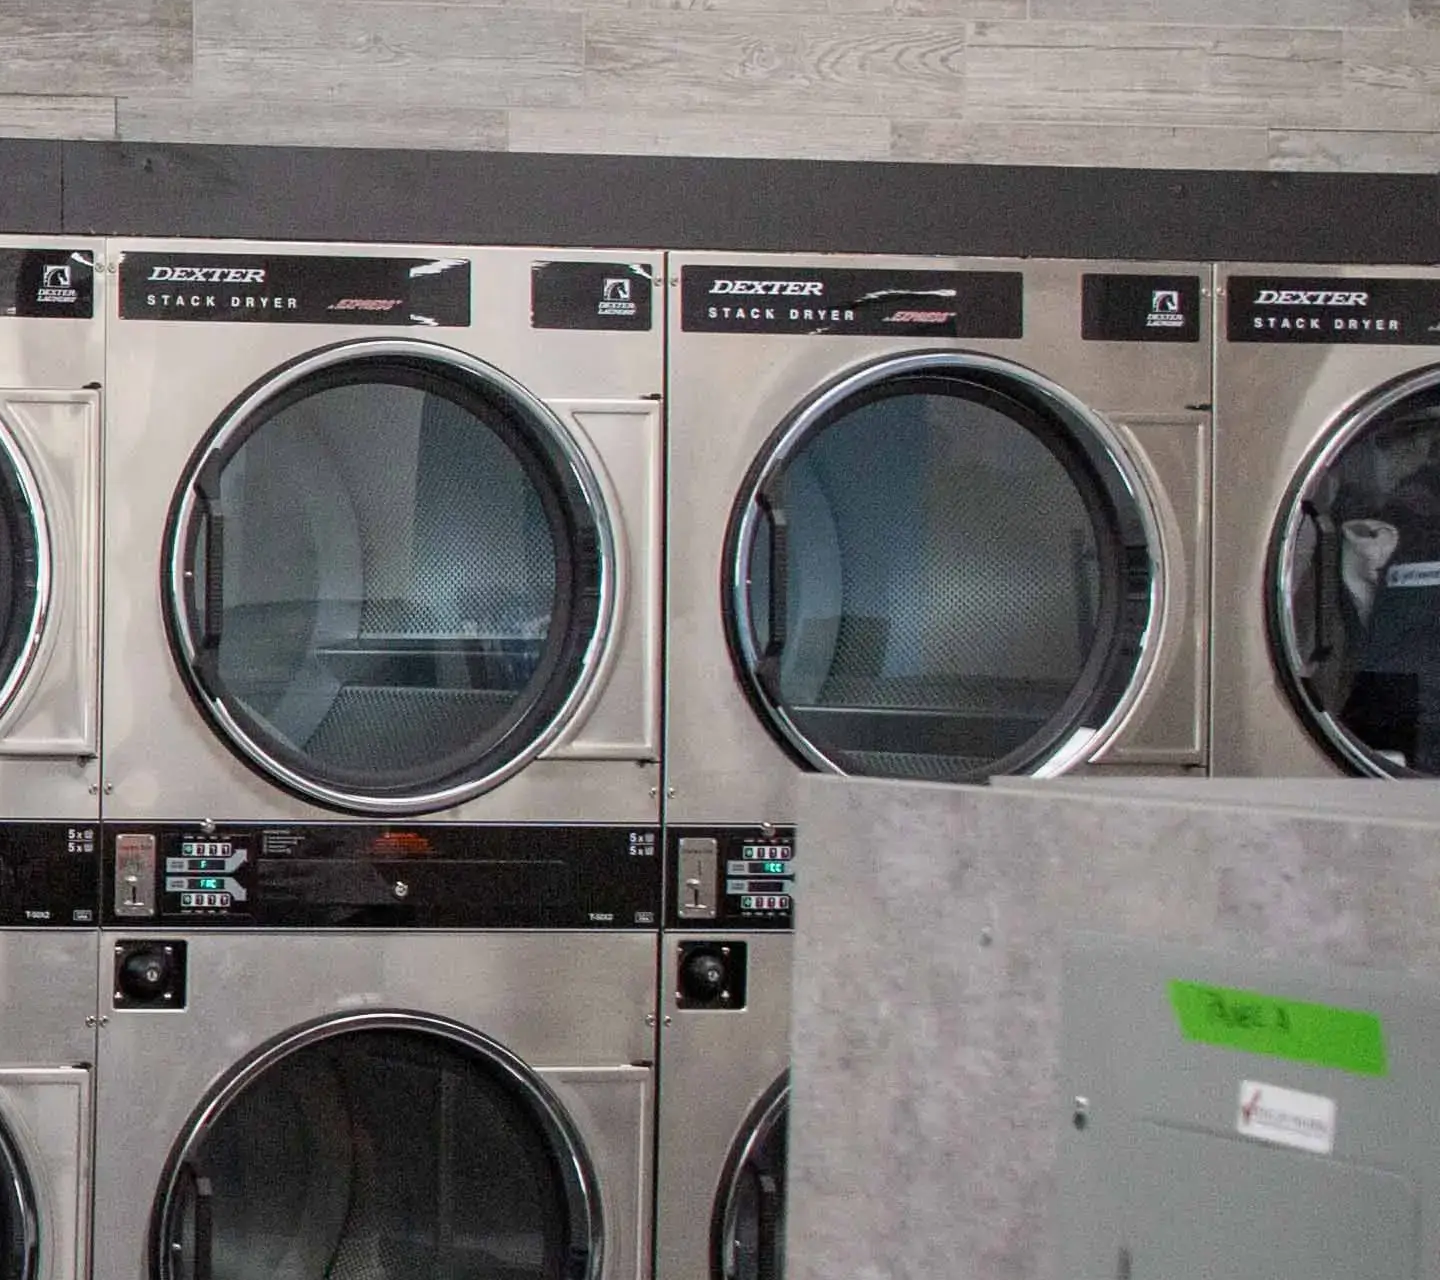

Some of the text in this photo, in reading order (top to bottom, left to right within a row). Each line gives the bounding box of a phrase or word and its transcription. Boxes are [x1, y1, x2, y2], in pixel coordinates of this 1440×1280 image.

[148, 266, 266, 283] DEXTER
[709, 279, 822, 296] DEXTER
[147, 295, 298, 308] STACK DRYER
[1254, 290, 1368, 306] DEXTER
[708, 308, 854, 321] STACK DRYER
[1254, 318, 1399, 331] STACK DRYER
